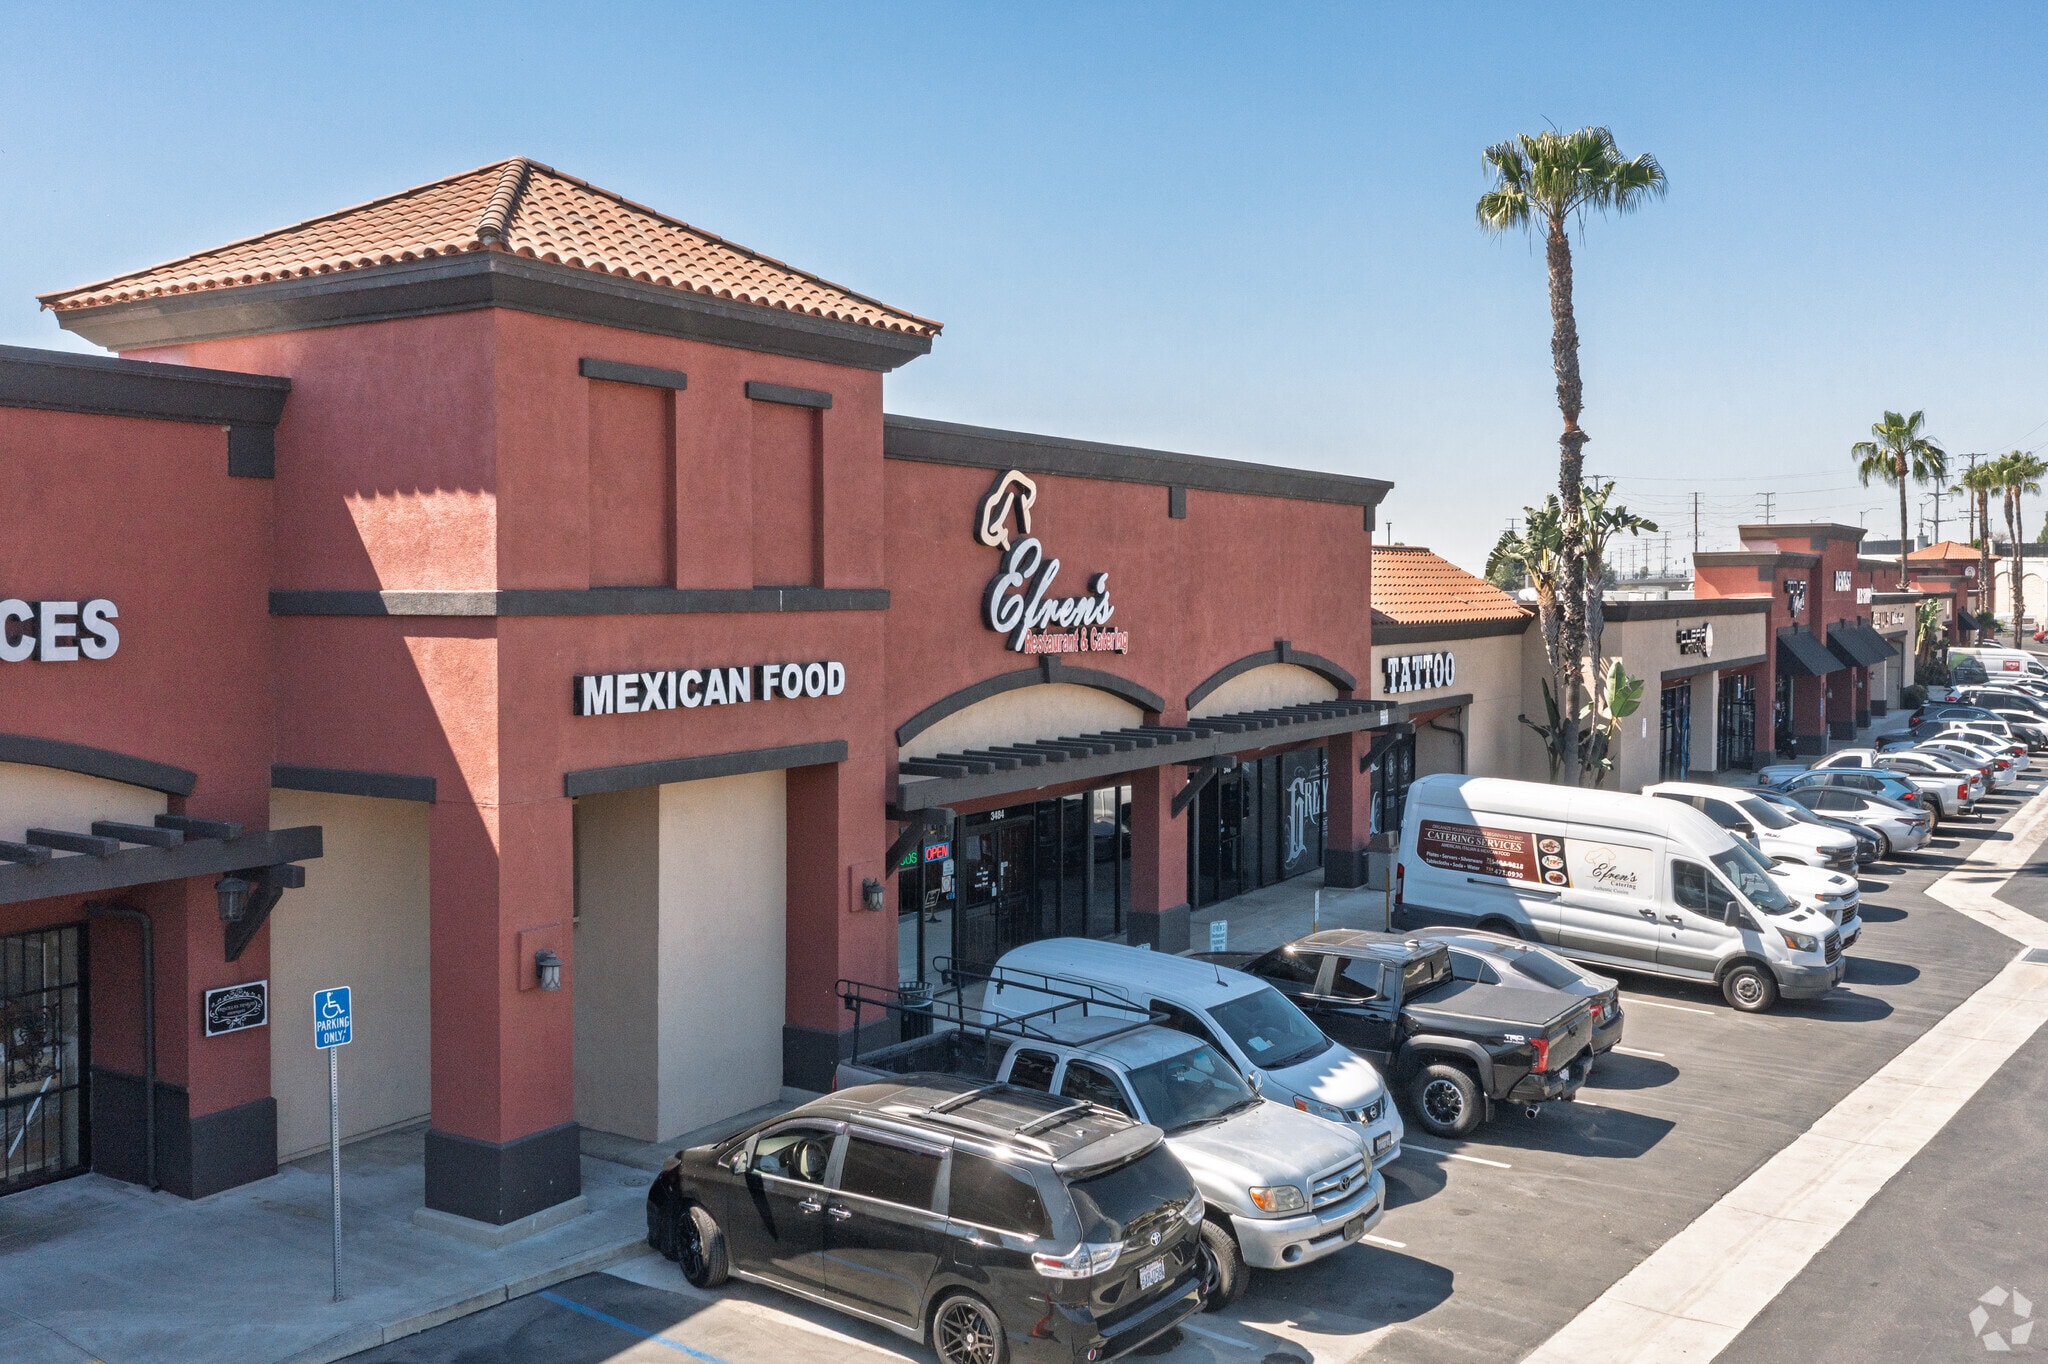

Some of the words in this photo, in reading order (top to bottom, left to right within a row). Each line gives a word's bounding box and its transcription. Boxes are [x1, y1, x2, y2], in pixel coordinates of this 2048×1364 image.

[991, 538, 1115, 652] Efren's
[0, 598, 120, 662] CES
[1024, 628, 1079, 654] Restaurant
[1080, 626, 1088, 651] &
[1090, 626, 1129, 655] Catering
[1387, 651, 1456, 694] TATTOO
[582, 667, 751, 716] MEXICAN
[762, 662, 846, 701] FOOD
[990, 809, 1005, 821] 3484
[1427, 830, 1474, 845] CATERING
[1476, 838, 1522, 851] SERVICES
[925, 845, 949, 861] OPEN
[1592, 863, 1638, 882] Efren's
[1611, 882, 1637, 890] Catering
[317, 1016, 350, 1032] PARKING
[324, 1030, 344, 1044] ONLY
[1504, 1033, 1525, 1041] TRD
